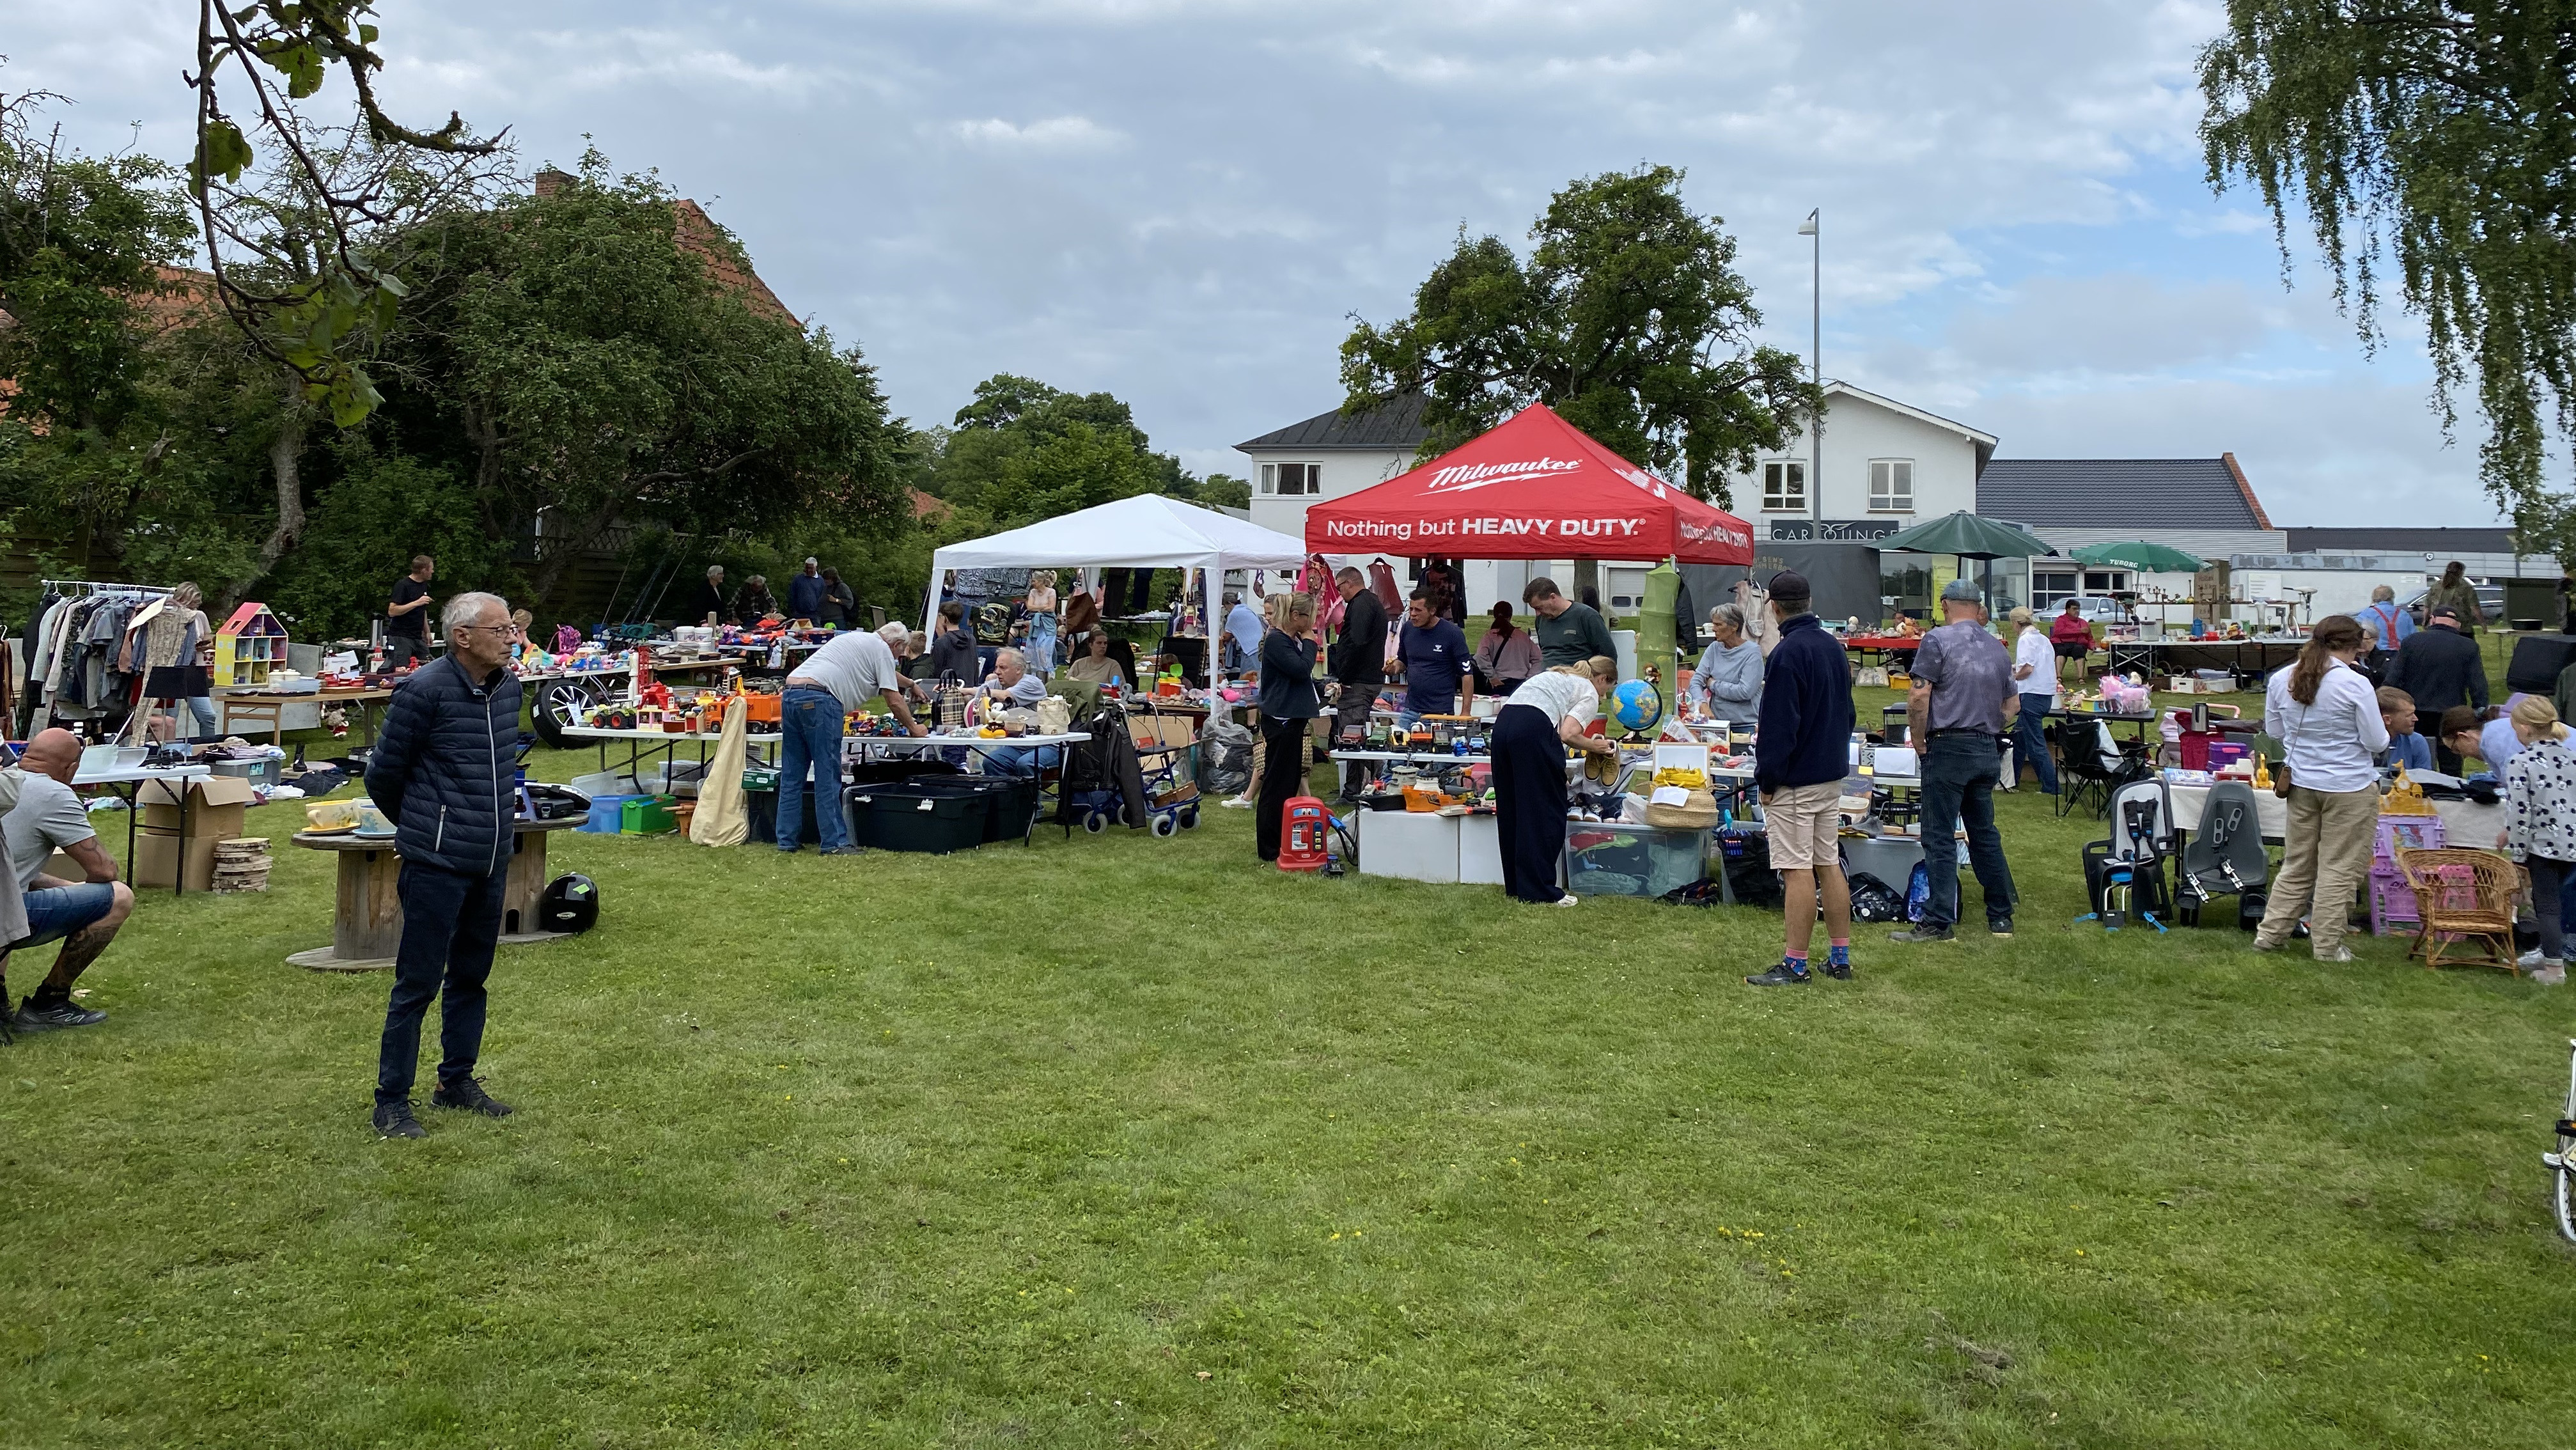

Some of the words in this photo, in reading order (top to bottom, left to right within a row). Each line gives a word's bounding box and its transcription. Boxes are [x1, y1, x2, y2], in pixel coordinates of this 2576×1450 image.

[1327, 520, 1412, 540] Nothing
[1419, 519, 1456, 536] but
[1462, 518, 1554, 535] HEAVY
[1772, 529, 1809, 540] CAR
[1823, 529, 1898, 541] OUNG
[2109, 559, 2139, 568] TUBORG
